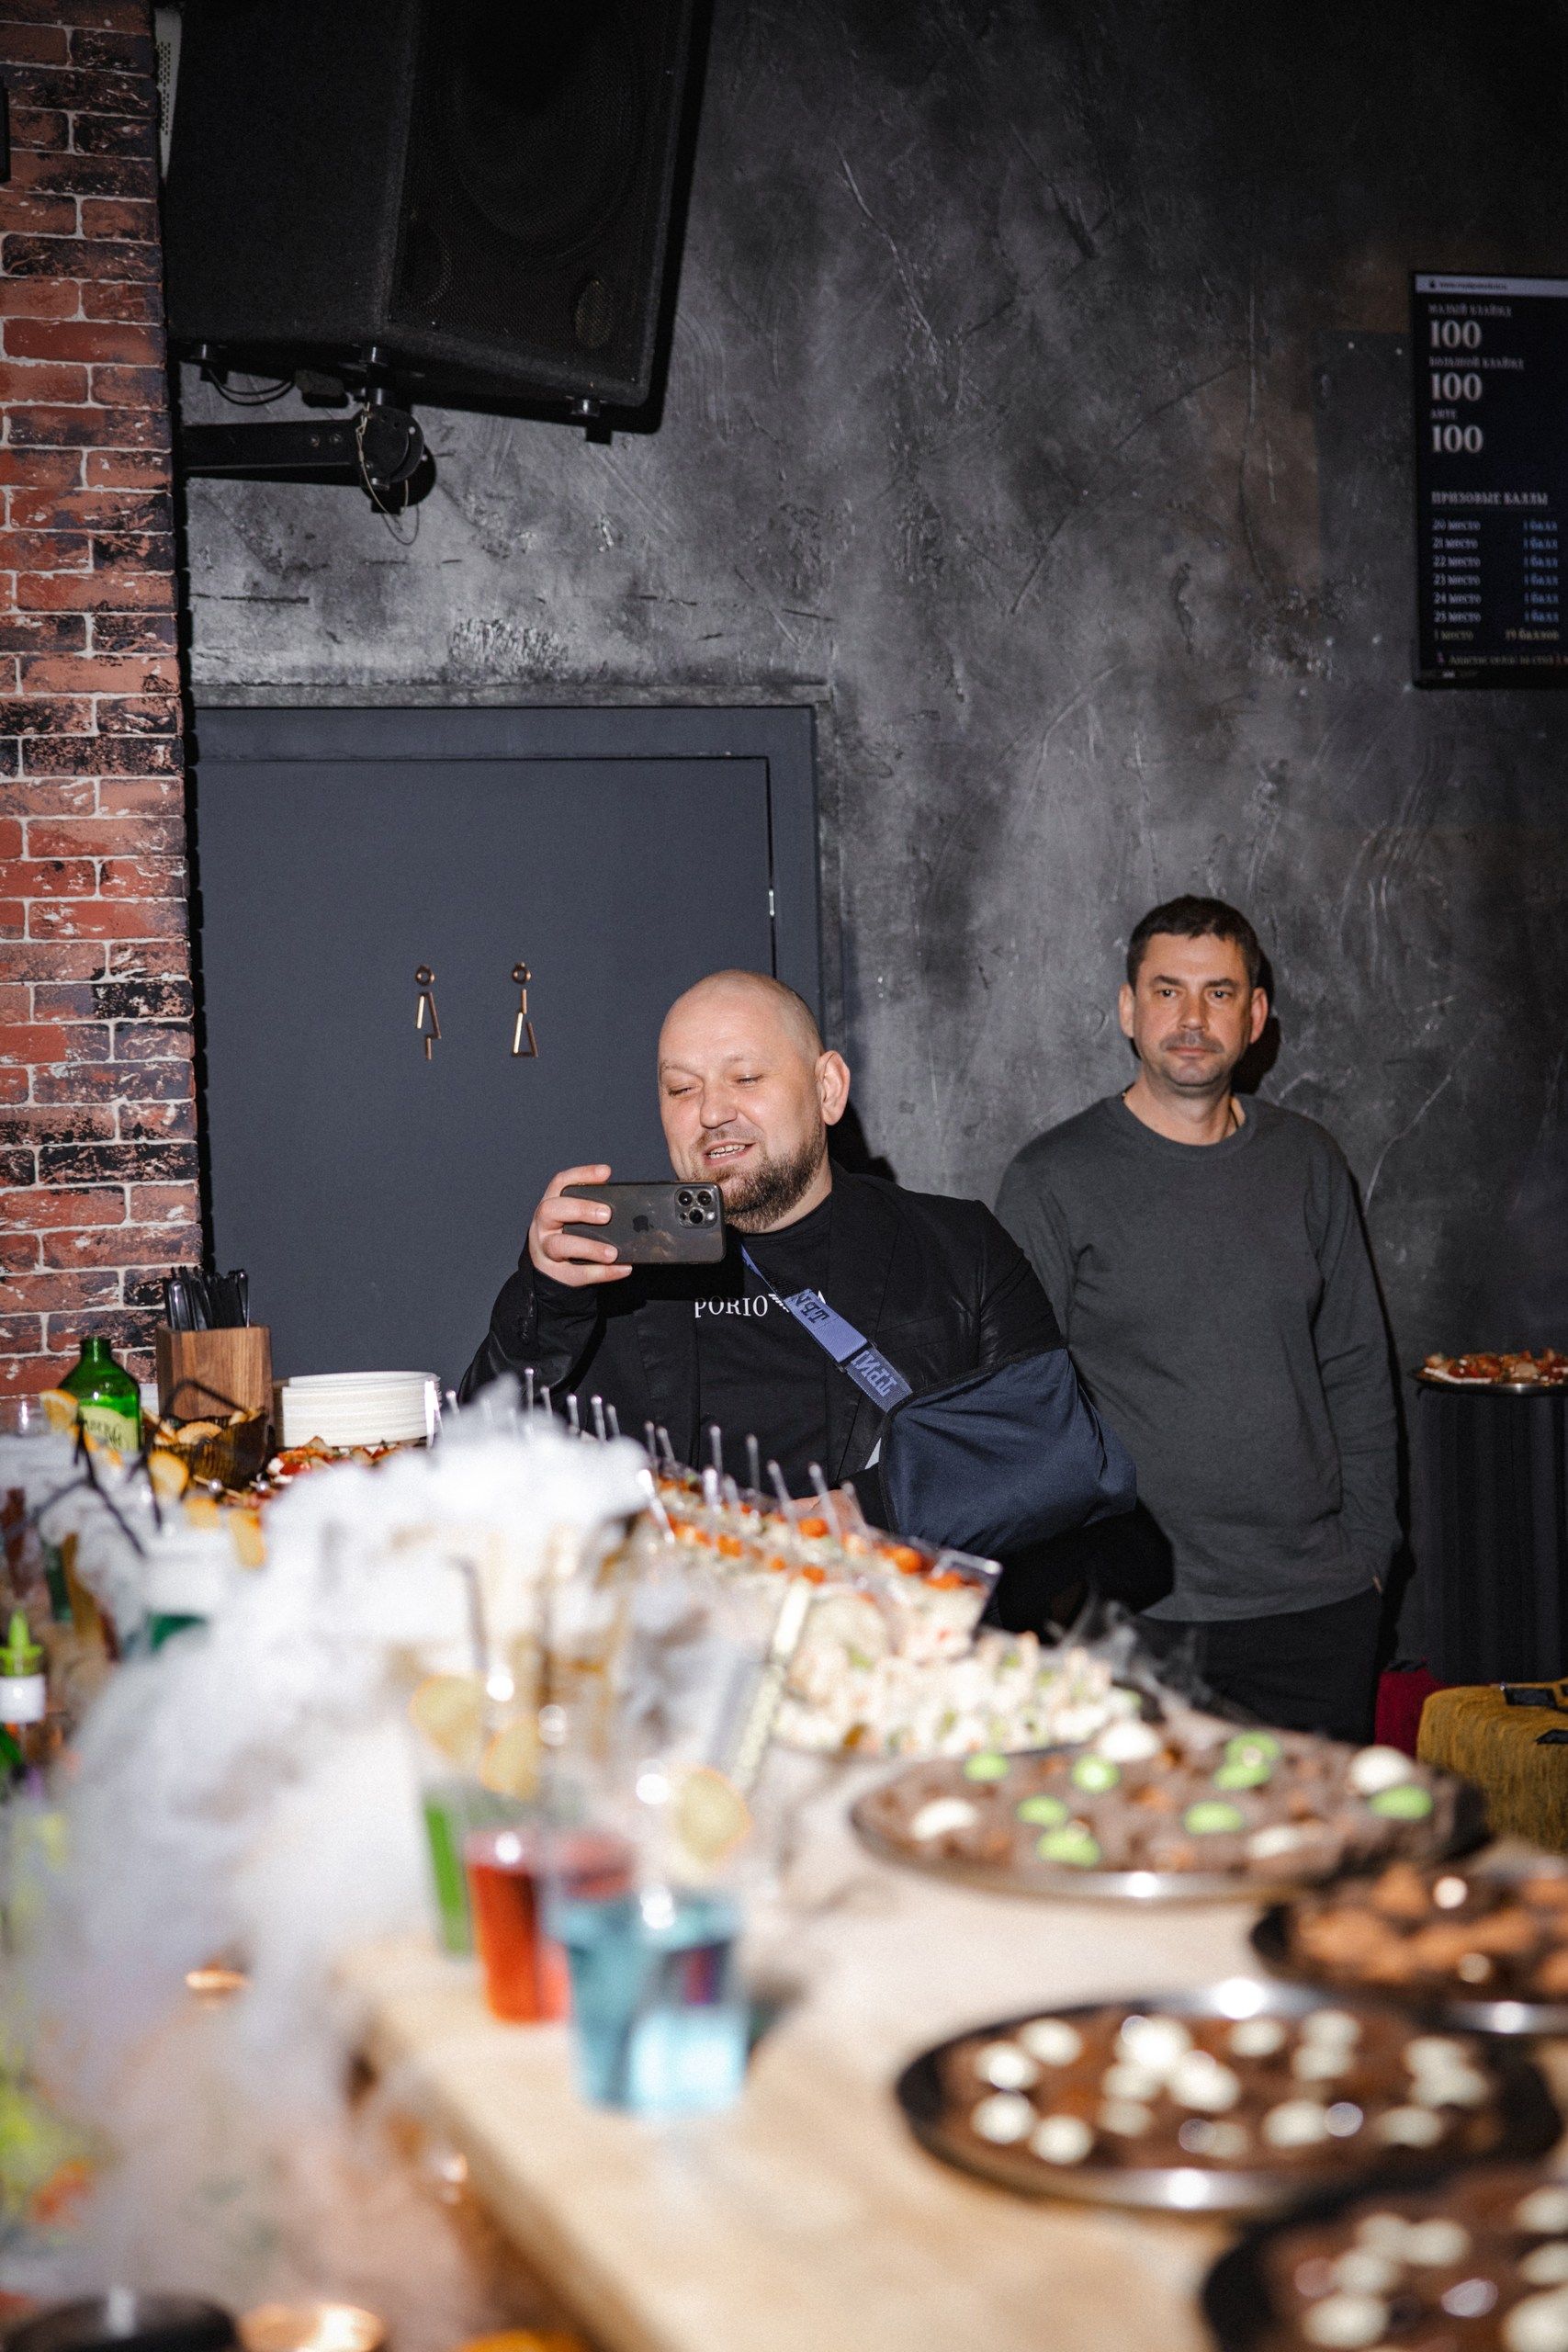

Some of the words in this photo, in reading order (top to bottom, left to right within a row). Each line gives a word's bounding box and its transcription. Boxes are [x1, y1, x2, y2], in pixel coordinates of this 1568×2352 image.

[1430, 319, 1482, 348] 100
[1431, 372, 1483, 401] 100
[1432, 424, 1483, 454] 100
